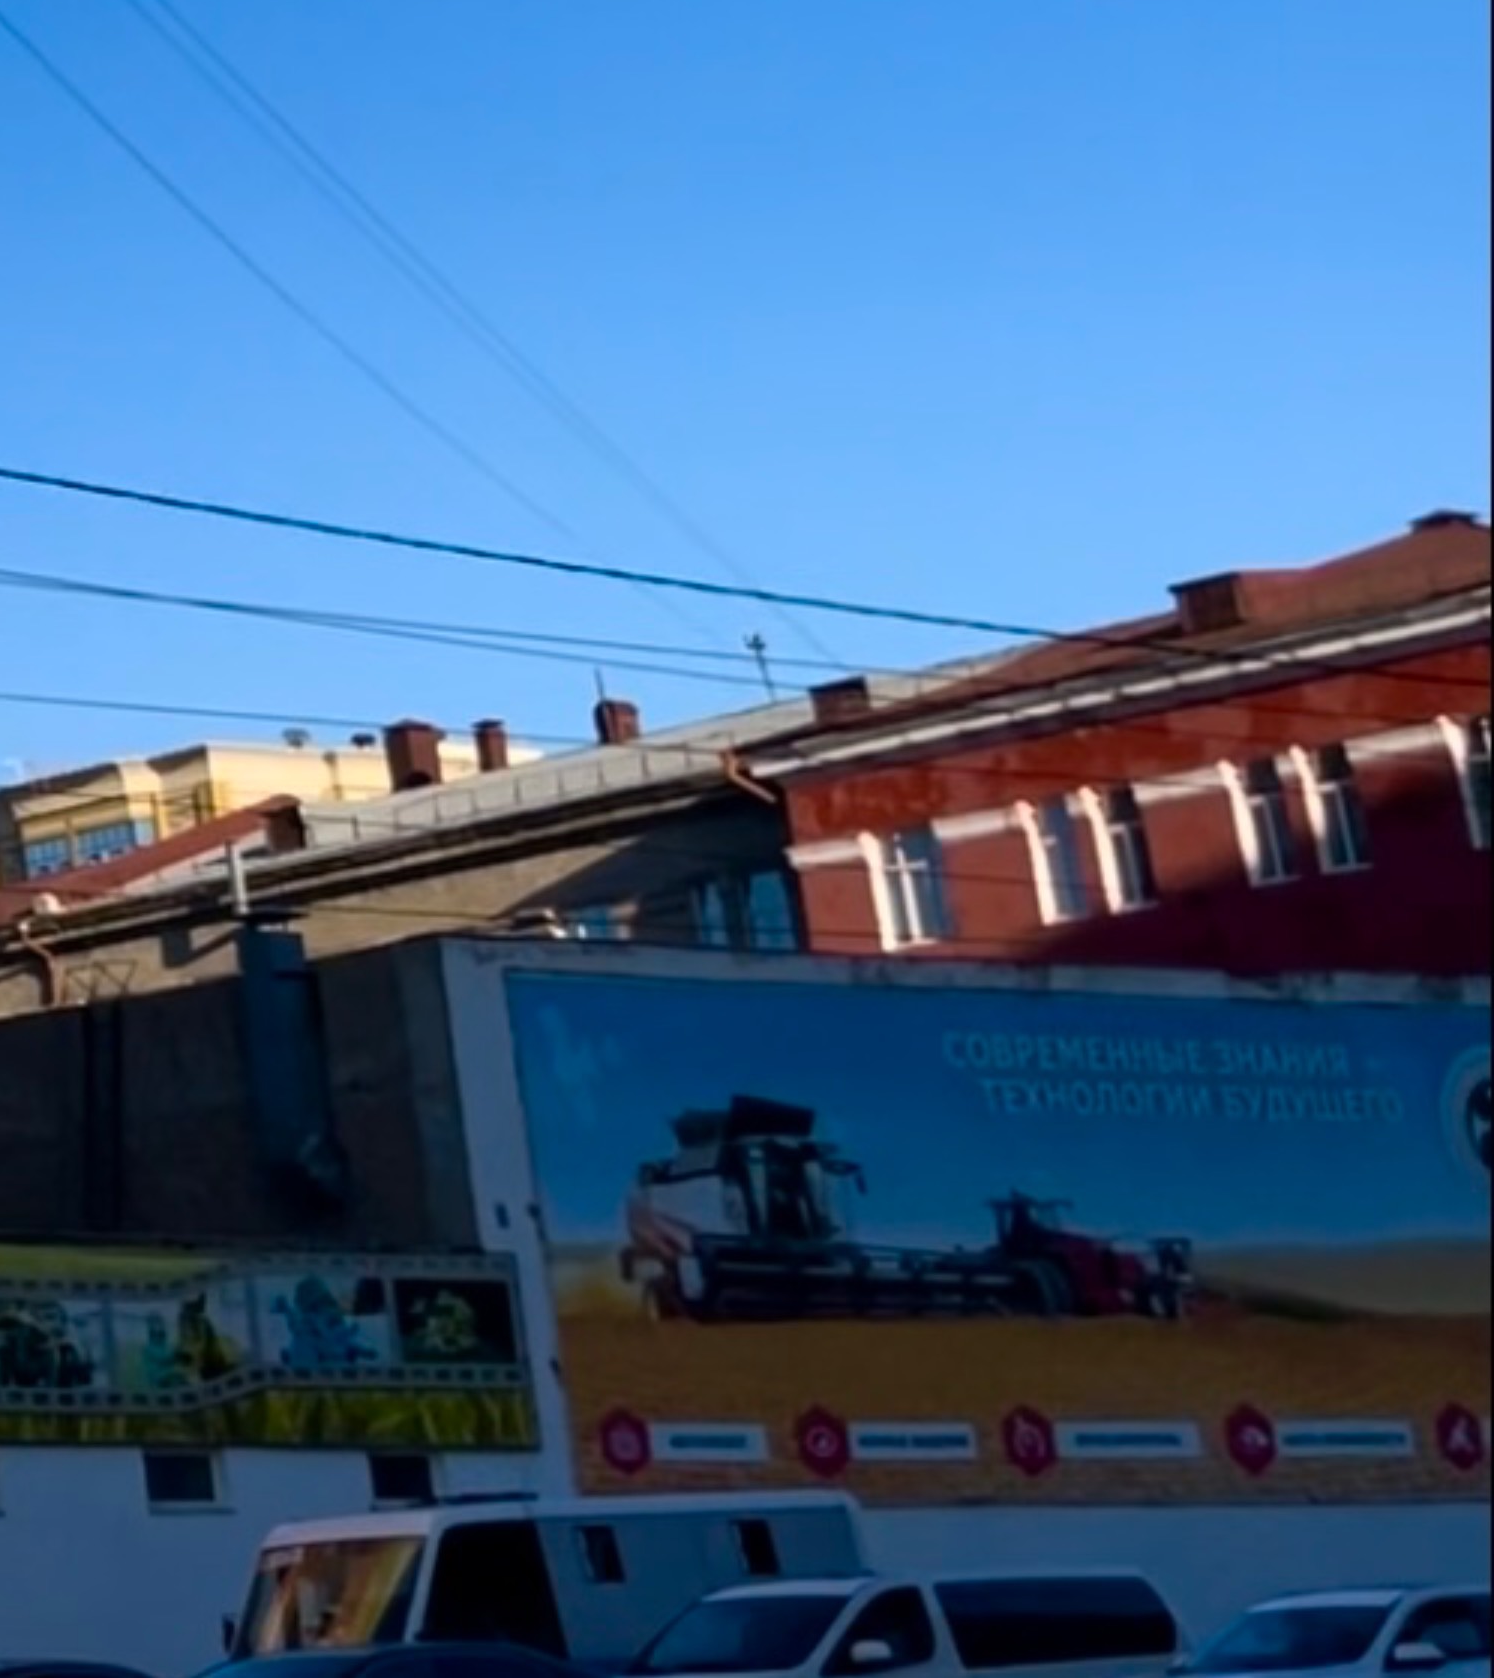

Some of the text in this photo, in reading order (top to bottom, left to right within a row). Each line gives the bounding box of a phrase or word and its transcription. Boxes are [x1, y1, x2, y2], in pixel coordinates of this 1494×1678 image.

[941, 1030, 1206, 1076] СОВРЕМЕННЫЕ
[1210, 1038, 1350, 1078] ЗНАНИЯ
[977, 1077, 1405, 1124] ТЕХНОЛОГИИ БУДУЩЕГО
